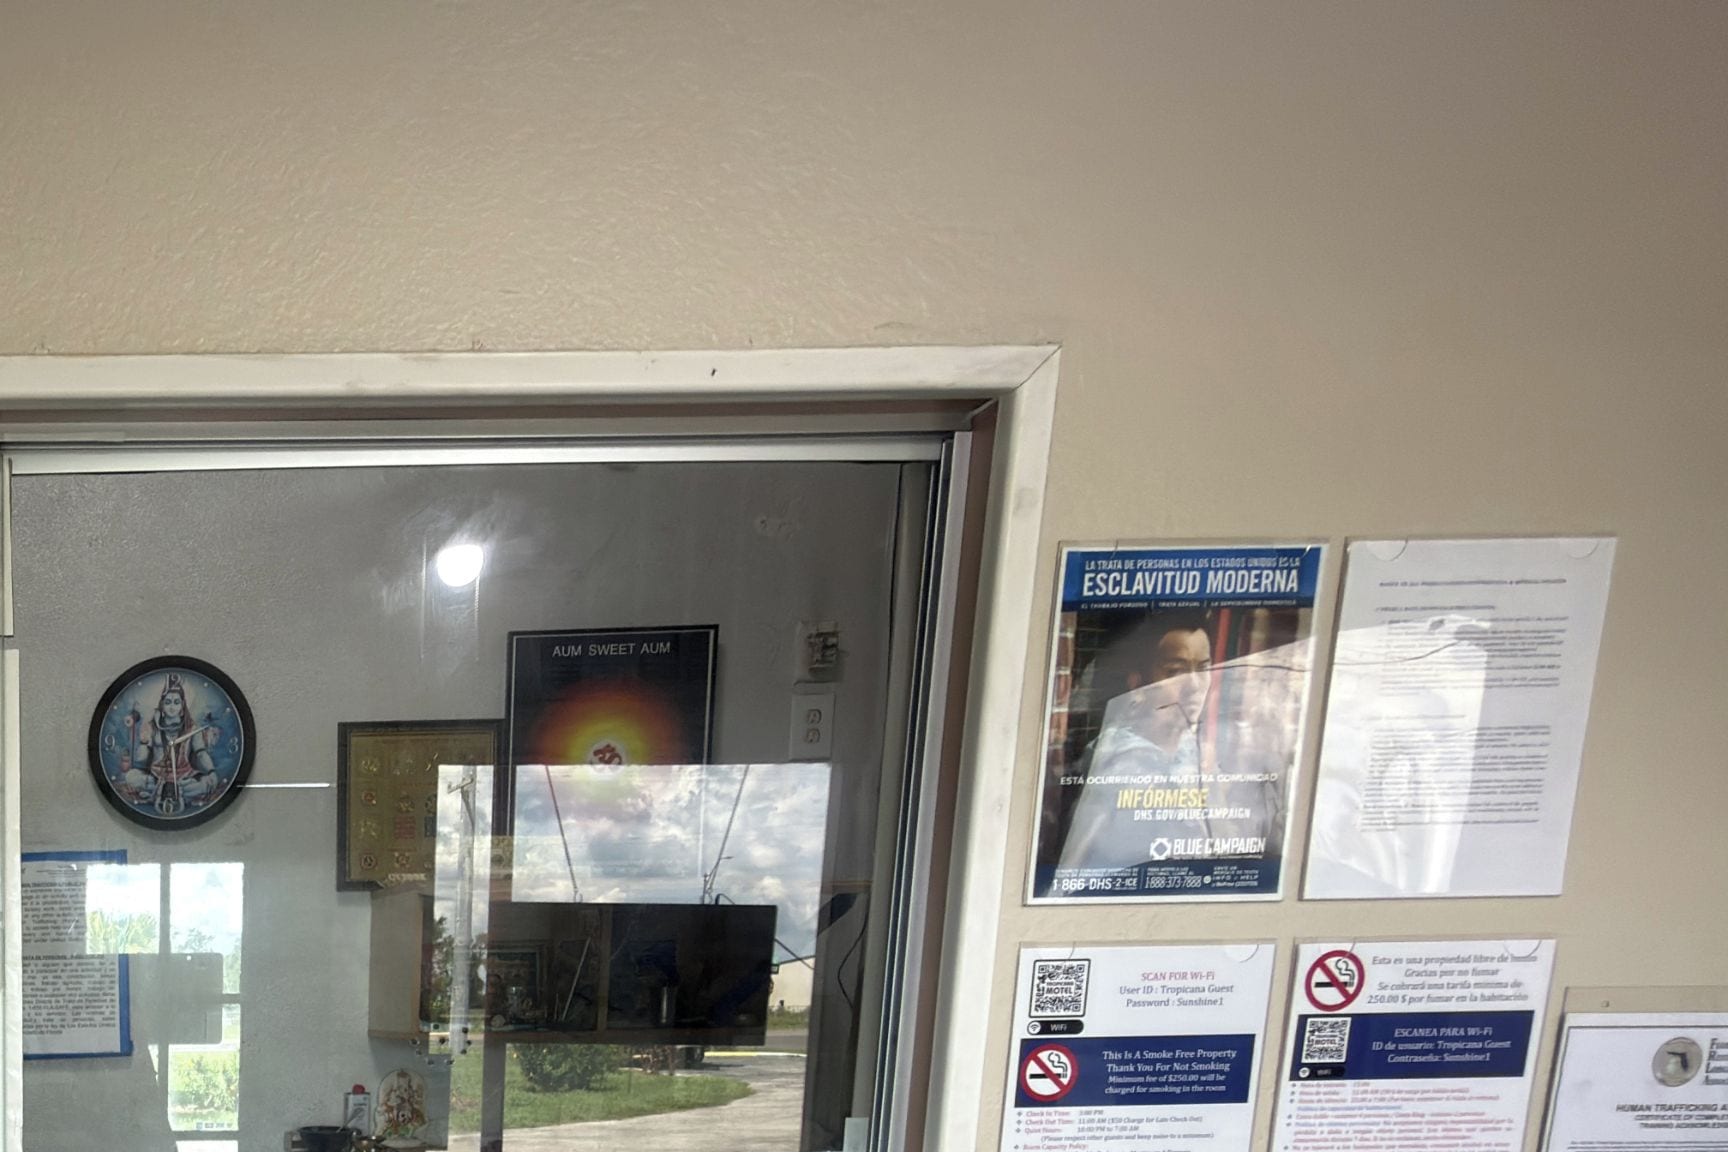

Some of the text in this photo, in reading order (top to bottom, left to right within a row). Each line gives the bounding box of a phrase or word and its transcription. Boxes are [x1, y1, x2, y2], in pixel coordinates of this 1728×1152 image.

[1085, 560, 1096, 570] LA
[1097, 559, 1122, 570] TRATA
[1124, 559, 1135, 570] DE
[1136, 558, 1179, 569] PERSONAS
[1181, 558, 1193, 569] EN
[1194, 558, 1210, 568] LOS
[1211, 557, 1247, 568] ESTADOS
[1083, 569, 1299, 596] ESCLAVITUD MODERNA
[552, 642, 671, 658] AUM SWEET AUM
[166, 673, 181, 690] 12
[105, 735, 116, 752] 9
[228, 736, 239, 754] 3
[1117, 785, 1209, 809] INFÓRMESE
[163, 797, 174, 814] 6
[1173, 837, 1266, 855] BLUE CAMPAIGN
[1372, 956, 1391, 965] Esta
[1424, 955, 1472, 966] propiedad
[1473, 955, 1496, 964] libre
[1497, 955, 1509, 963] de
[1141, 971, 1216, 981] SCAN FOR Wi-Fi
[1404, 968, 1501, 979] Gracias por no fumar
[1046, 987, 1073, 995] MOTEL
[1119, 986, 1140, 995] User
[1142, 986, 1154, 994] ID
[1160, 985, 1206, 996] Tropicana
[1207, 984, 1234, 993] Guest
[1126, 998, 1170, 1007] Password
[1176, 997, 1224, 1006] Sunshine1
[1367, 995, 1399, 1004] 250.00
[1400, 995, 1407, 1004] $
[1408, 995, 1425, 1005] por
[1426, 994, 1454, 1003] fumar
[1470, 993, 1478, 1002] la
[1050, 1023, 1067, 1032] WiFi
[1394, 1027, 1493, 1037] ESCANEA PARA Wi-Fi
[1372, 1041, 1383, 1051] ID
[1384, 1041, 1396, 1051] de
[1436, 1040, 1483, 1051] Tropicana
[1484, 1040, 1512, 1049] Guest
[1102, 1049, 1237, 1060] This Is A Smoke Free Property
[1106, 1062, 1230, 1072] Thank You For Not Smoking
[1158, 1075, 1167, 1083] of
[1168, 1074, 1199, 1082] $250.00
[1215, 1073, 1226, 1081] be
[1105, 1086, 1135, 1095] charged
[1149, 1085, 1181, 1094] smoking
[1615, 1103, 1652, 1112] HUMAN
[1655, 1103, 1718, 1112] TRAFFICKING
